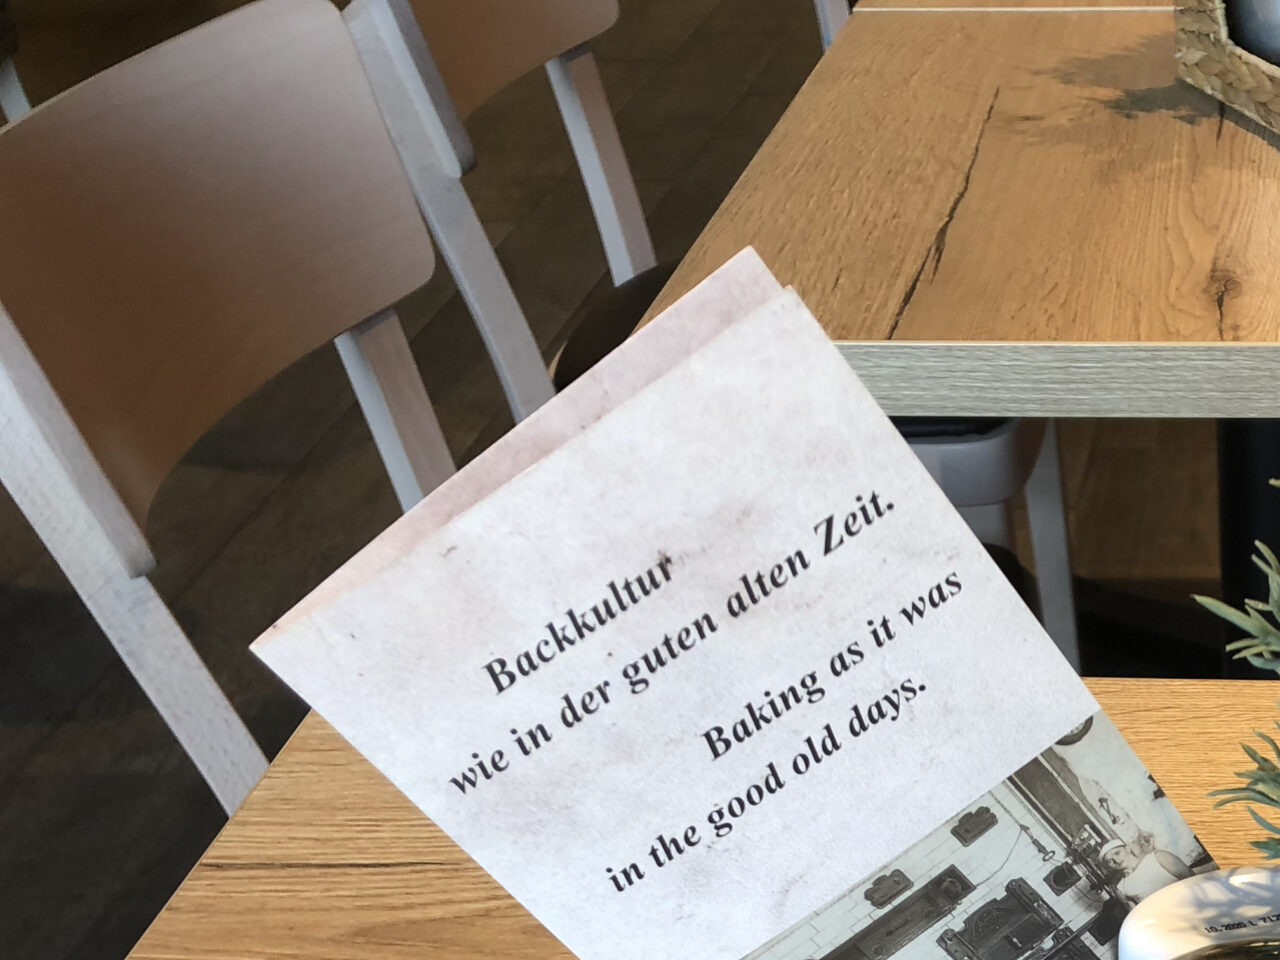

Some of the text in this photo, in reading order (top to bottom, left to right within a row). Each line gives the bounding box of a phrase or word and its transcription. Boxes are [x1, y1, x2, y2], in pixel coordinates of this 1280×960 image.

[449, 490, 895, 794] wie in der guten alten Zeit.
[481, 554, 672, 694] Backkultur
[700, 572, 963, 761] Baking as it was
[606, 678, 927, 892] in the good old days.
